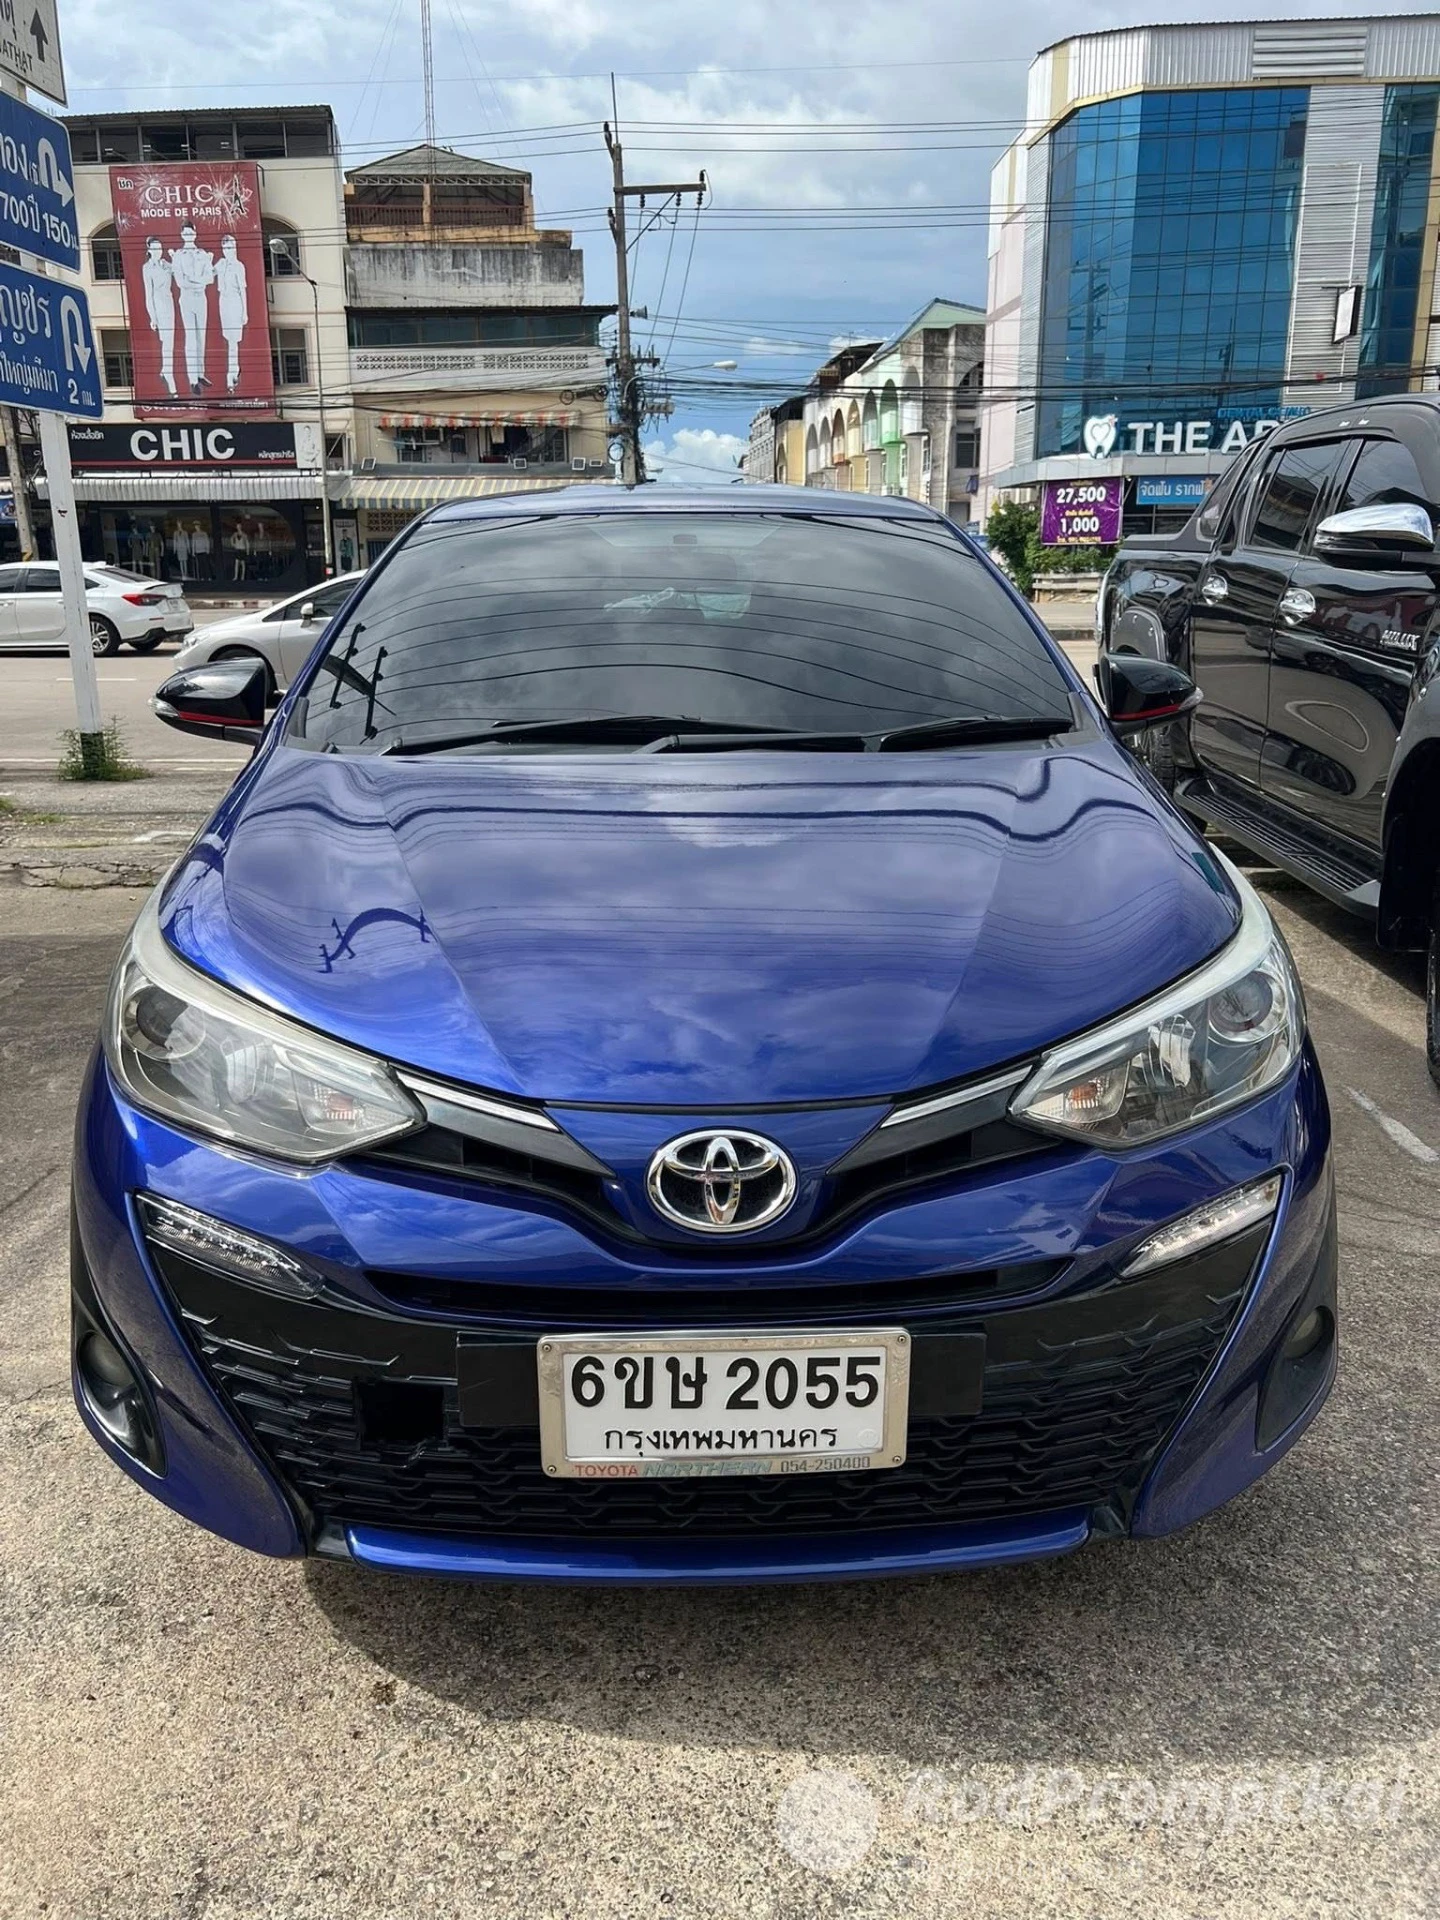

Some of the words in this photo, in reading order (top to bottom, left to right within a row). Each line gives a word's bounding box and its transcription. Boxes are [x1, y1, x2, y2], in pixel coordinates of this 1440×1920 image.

[145, 184, 214, 204] CHIC
[141, 208, 171, 218] MODE
[174, 207, 189, 217] DE
[192, 206, 222, 217] PARIS
[68, 378, 79, 404] 2
[130, 428, 235, 461] CHIC
[1127, 420, 1211, 456] THE
[1056, 485, 1107, 505] 27,500
[1060, 516, 1100, 535] 1,000
[725, 1355, 881, 1410] 2055
[604, 1427, 838, 1457] กรุงเทพมหานคร
[574, 1463, 639, 1478] TOYOTA
[642, 1460, 773, 1477] NORTHERN
[780, 1456, 871, 1474] 054-250400
